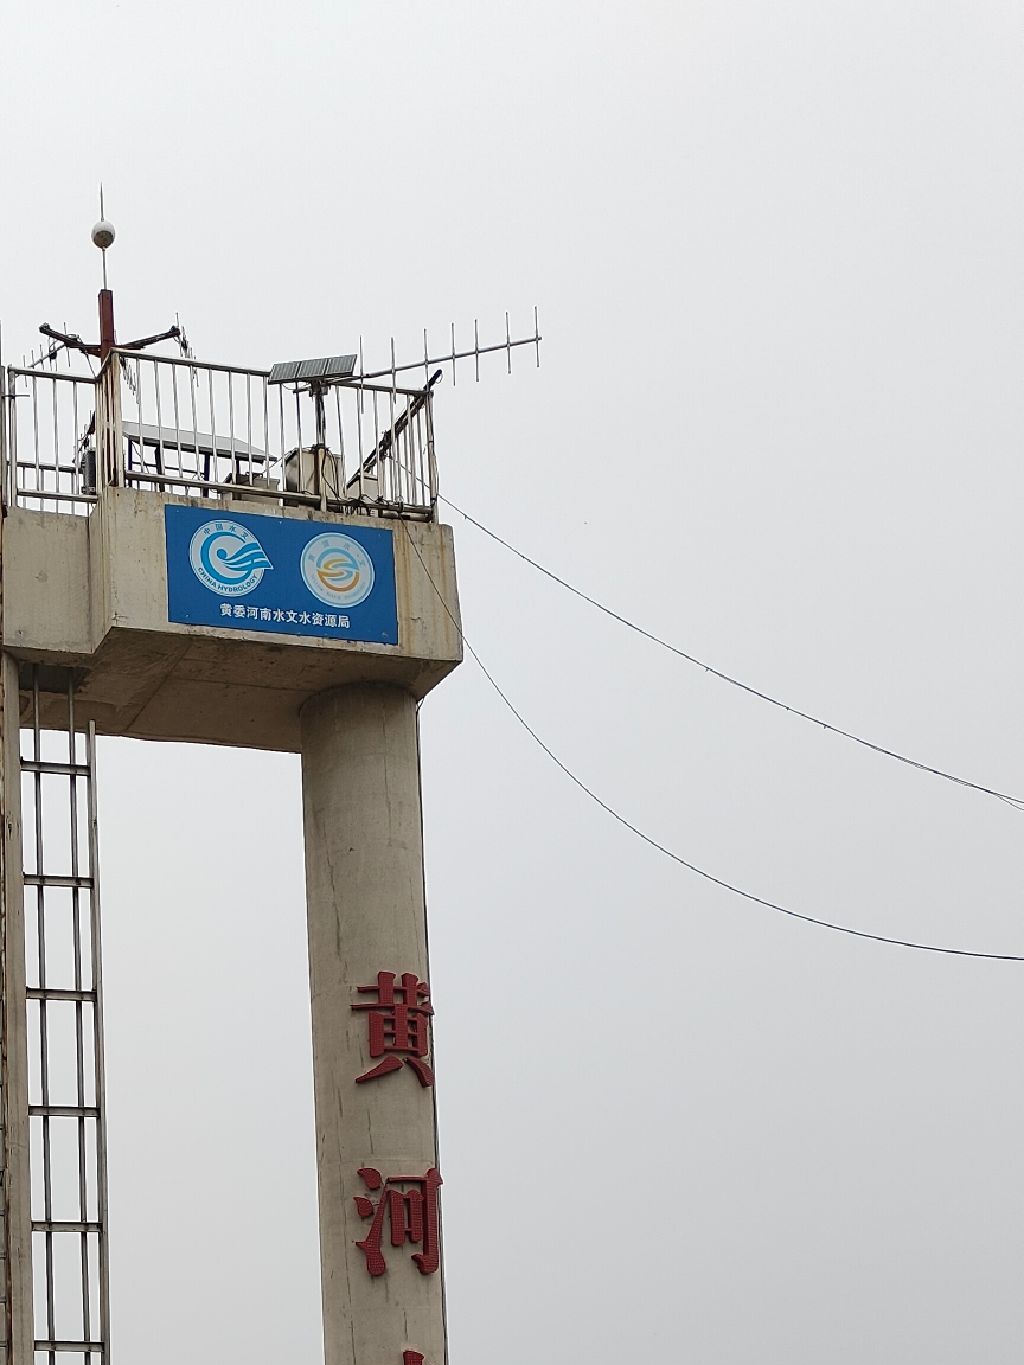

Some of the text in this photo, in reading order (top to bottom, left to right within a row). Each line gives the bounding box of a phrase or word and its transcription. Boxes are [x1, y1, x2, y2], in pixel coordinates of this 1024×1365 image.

[197, 566, 257, 592] CHINA HYDROLOGY
[220, 603, 350, 629] 黄委河南水文水资源局
